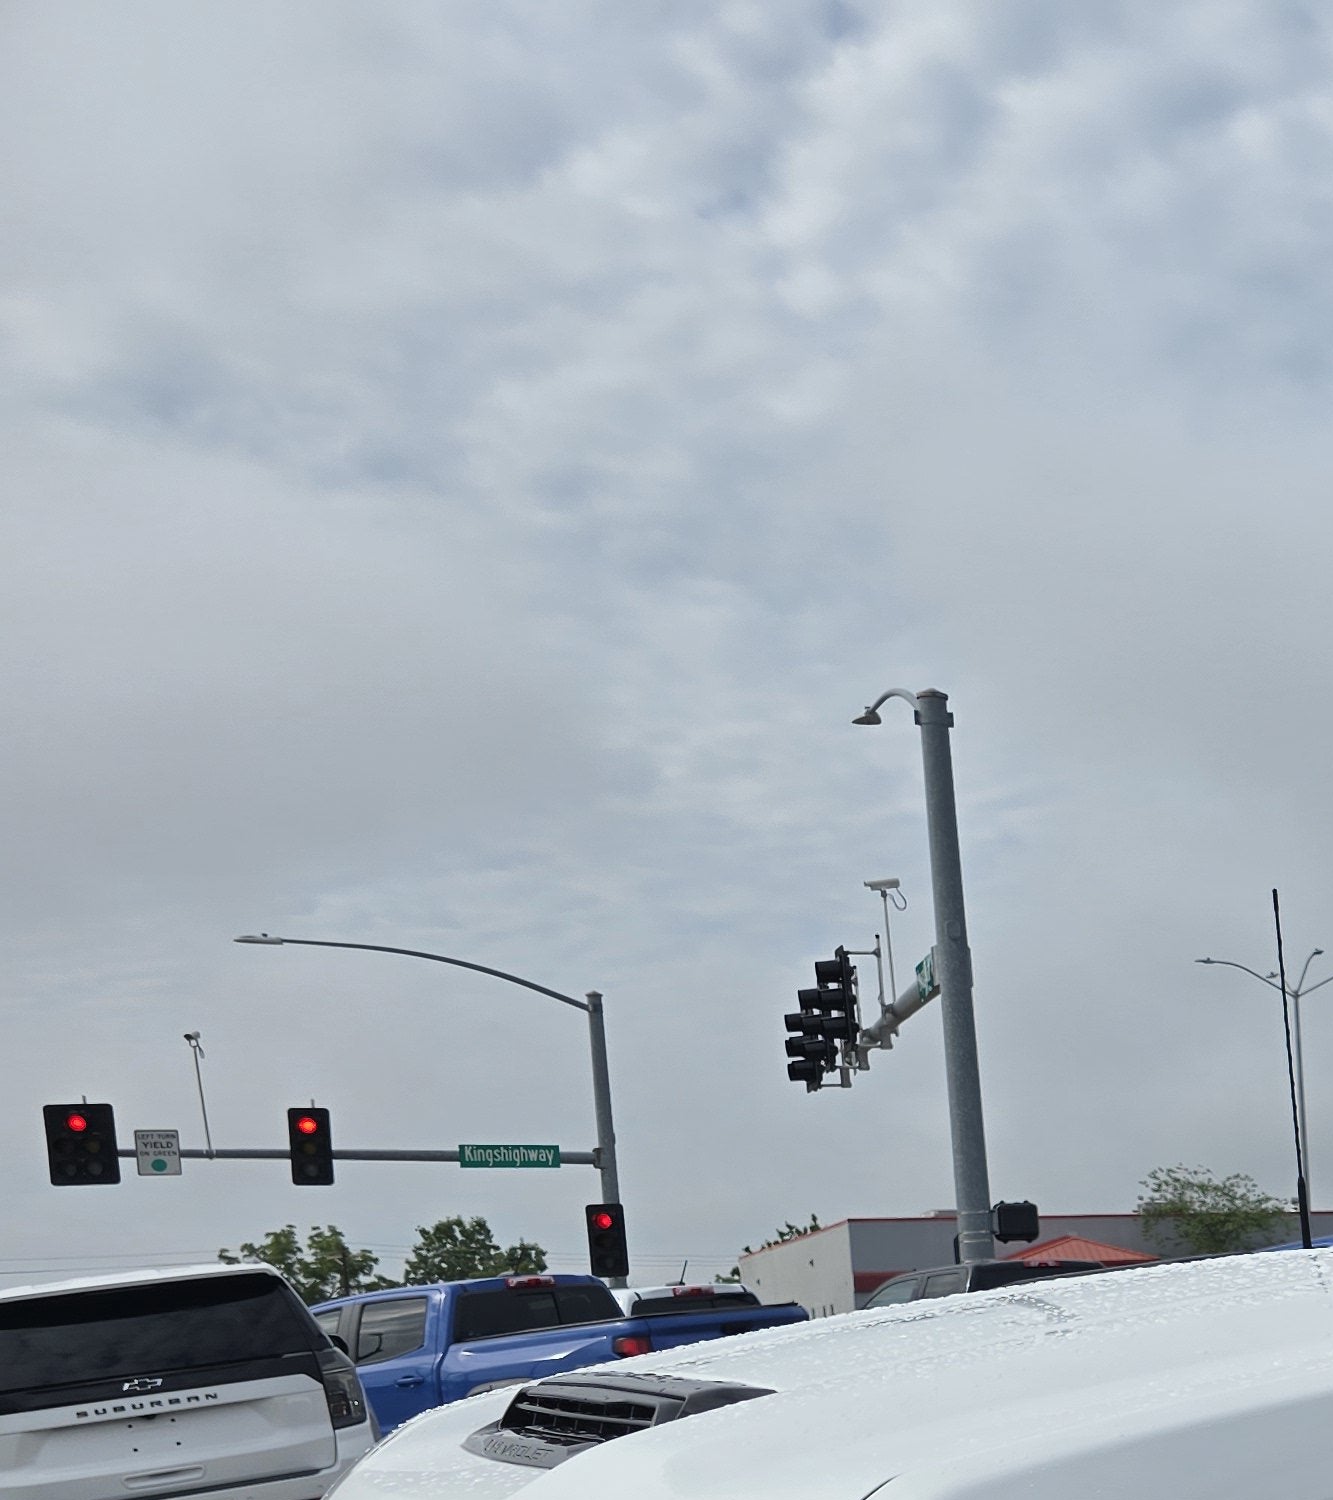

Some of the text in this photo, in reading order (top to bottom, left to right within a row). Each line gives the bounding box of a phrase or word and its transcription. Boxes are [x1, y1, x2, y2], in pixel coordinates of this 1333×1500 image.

[142, 1141, 174, 1149] YIELD
[464, 1145, 555, 1167] Kingshighway
[76, 1392, 219, 1419] SUBURBAN
